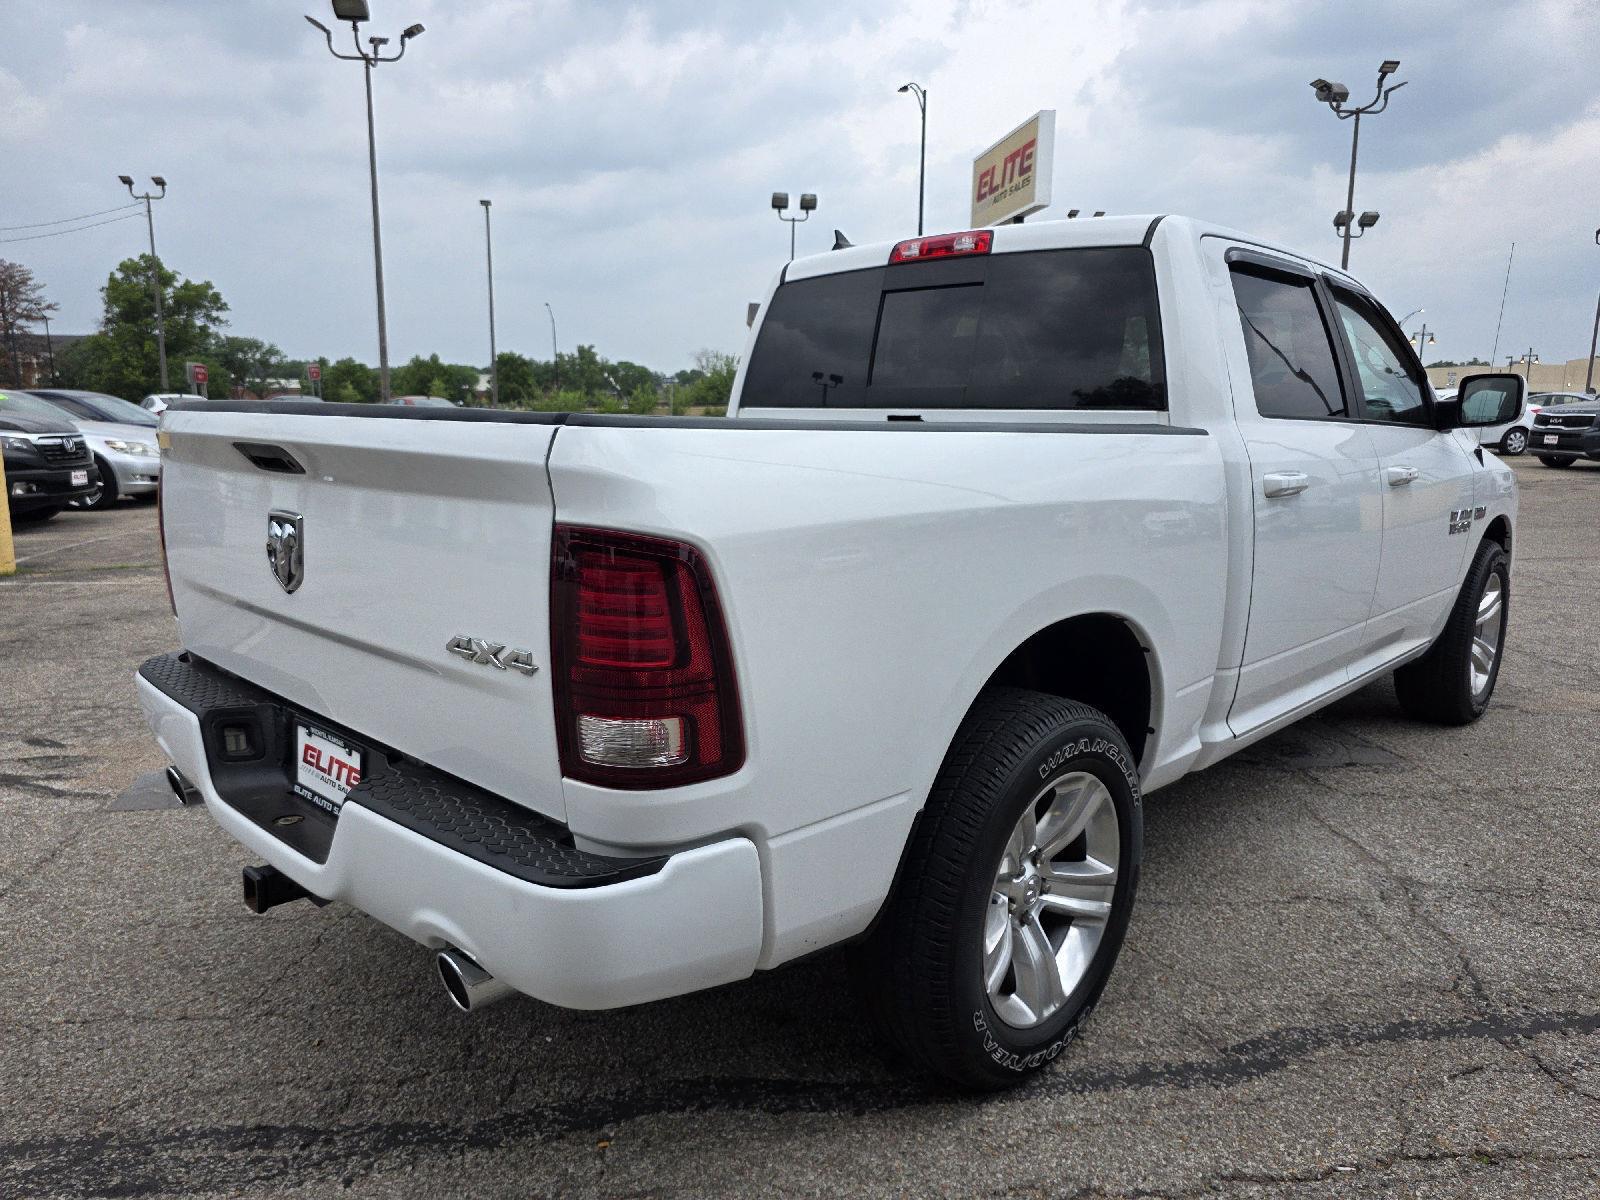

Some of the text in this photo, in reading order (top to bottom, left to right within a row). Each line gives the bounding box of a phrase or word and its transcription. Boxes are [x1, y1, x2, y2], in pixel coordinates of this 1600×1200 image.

[976, 138, 1037, 203] ELITE
[1009, 175, 1032, 195] SALES
[303, 743, 360, 788] ELITE
[320, 775, 336, 789] AUTO
[1039, 738, 1142, 808] WRANGLER
[294, 784, 313, 801] ELITE
[313, 795, 332, 812] AUTO
